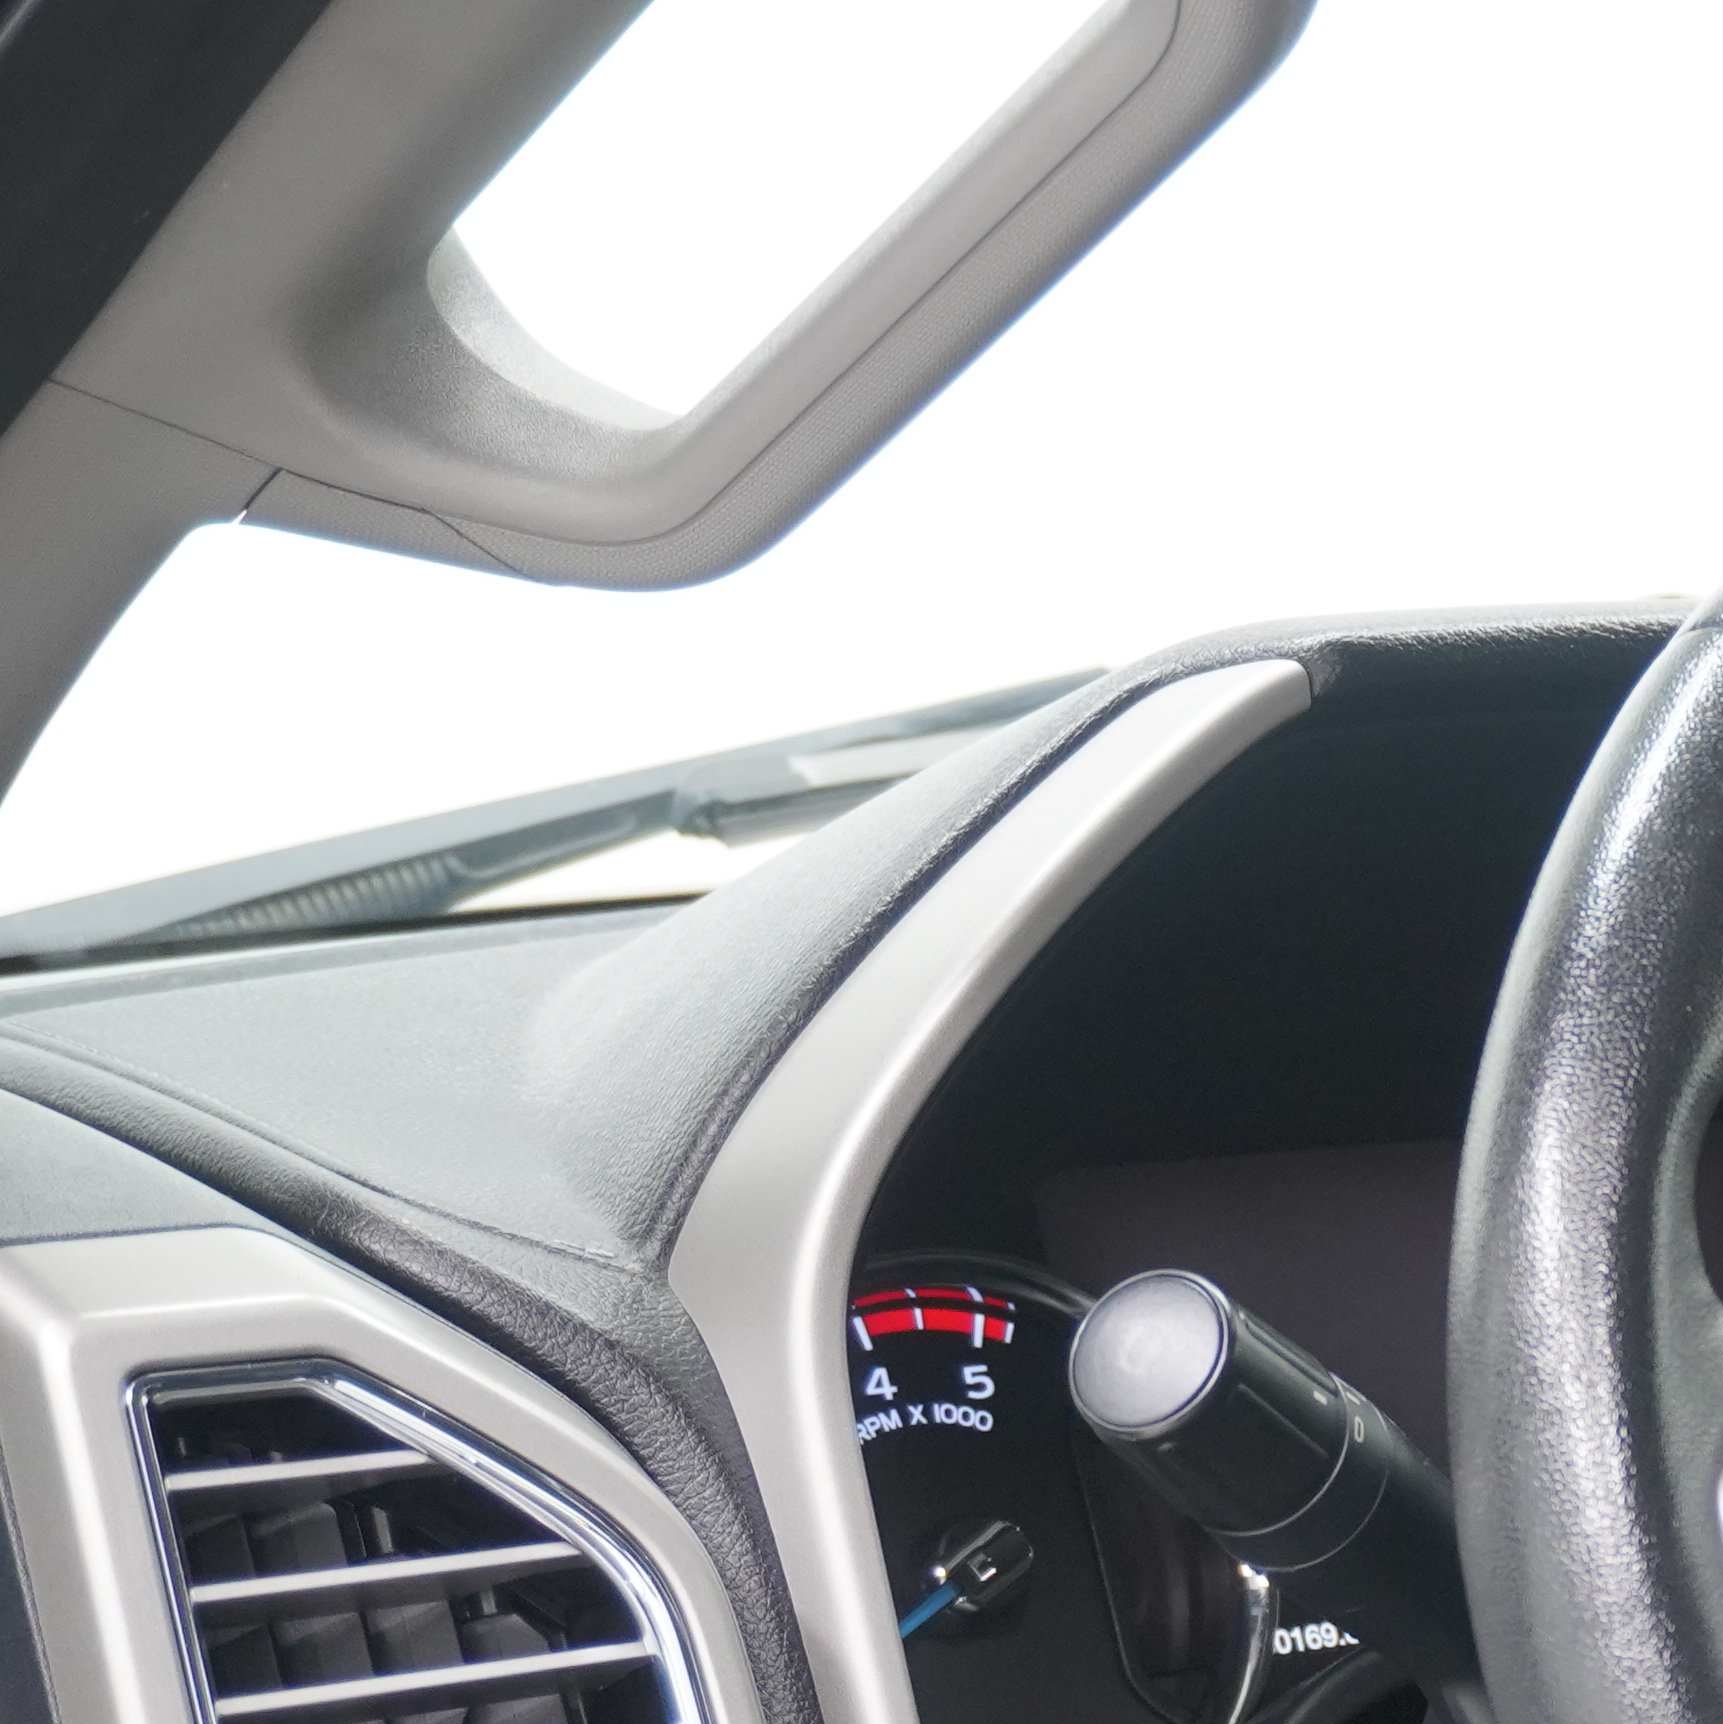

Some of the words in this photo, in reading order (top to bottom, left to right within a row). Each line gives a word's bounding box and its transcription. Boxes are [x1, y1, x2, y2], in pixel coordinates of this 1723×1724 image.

[866, 1367, 898, 1400] 4
[963, 1364, 996, 1400] 5
[856, 1407, 904, 1445] RPM
[908, 1404, 928, 1426] X
[933, 1403, 994, 1432] 1000
